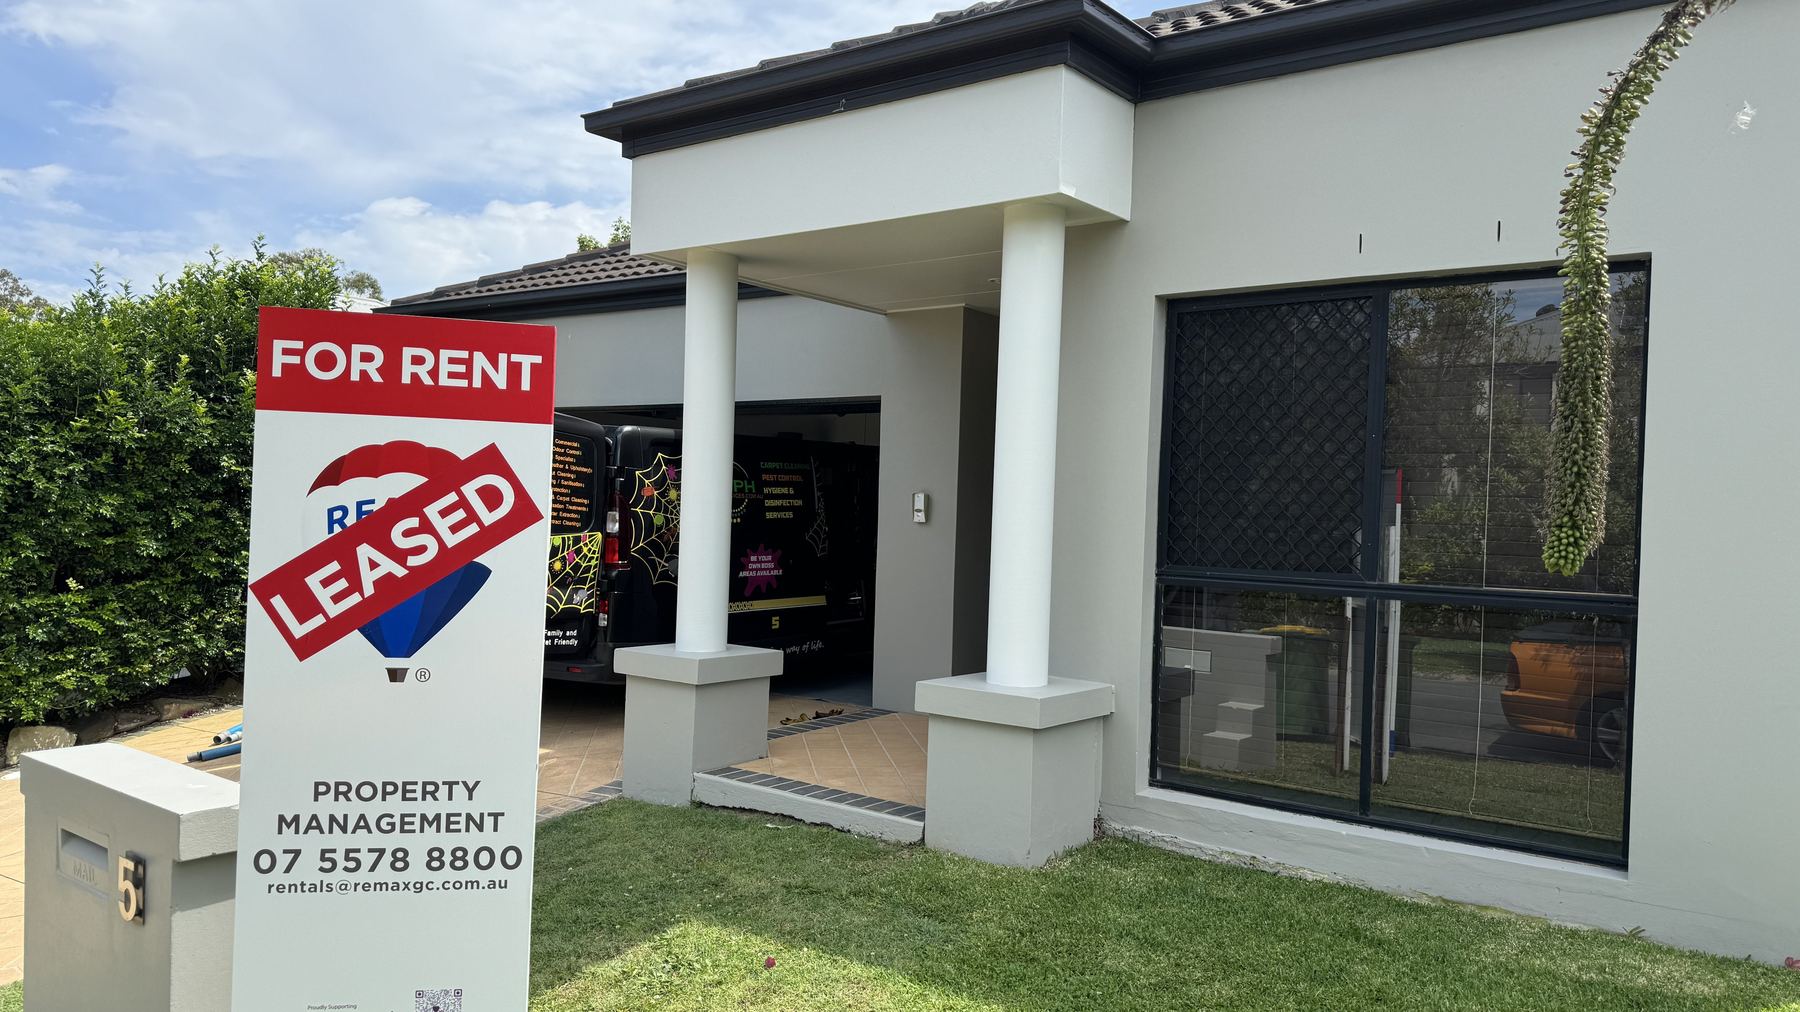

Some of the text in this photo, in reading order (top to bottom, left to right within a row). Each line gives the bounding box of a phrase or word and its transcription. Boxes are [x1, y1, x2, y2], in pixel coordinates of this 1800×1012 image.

[271, 339, 543, 391] FOR RENT
[778, 474, 804, 482] CONTROL
[764, 499, 803, 507] DISINFECTION
[766, 511, 794, 519] SERVICES
[269, 473, 515, 640] LEASED
[757, 569, 783, 577] AVAILABLE
[544, 629, 577, 638] Family and
[554, 638, 578, 647] Friendly
[786, 646, 800, 655] way
[801, 644, 811, 654] of
[313, 780, 481, 802] PROPERTY
[277, 812, 505, 835] MANAGEMENT
[253, 845, 523, 875] 07 5578 8800
[118, 855, 138, 922] 5
[267, 879, 508, 896] rentals@remaxgc.com.au
